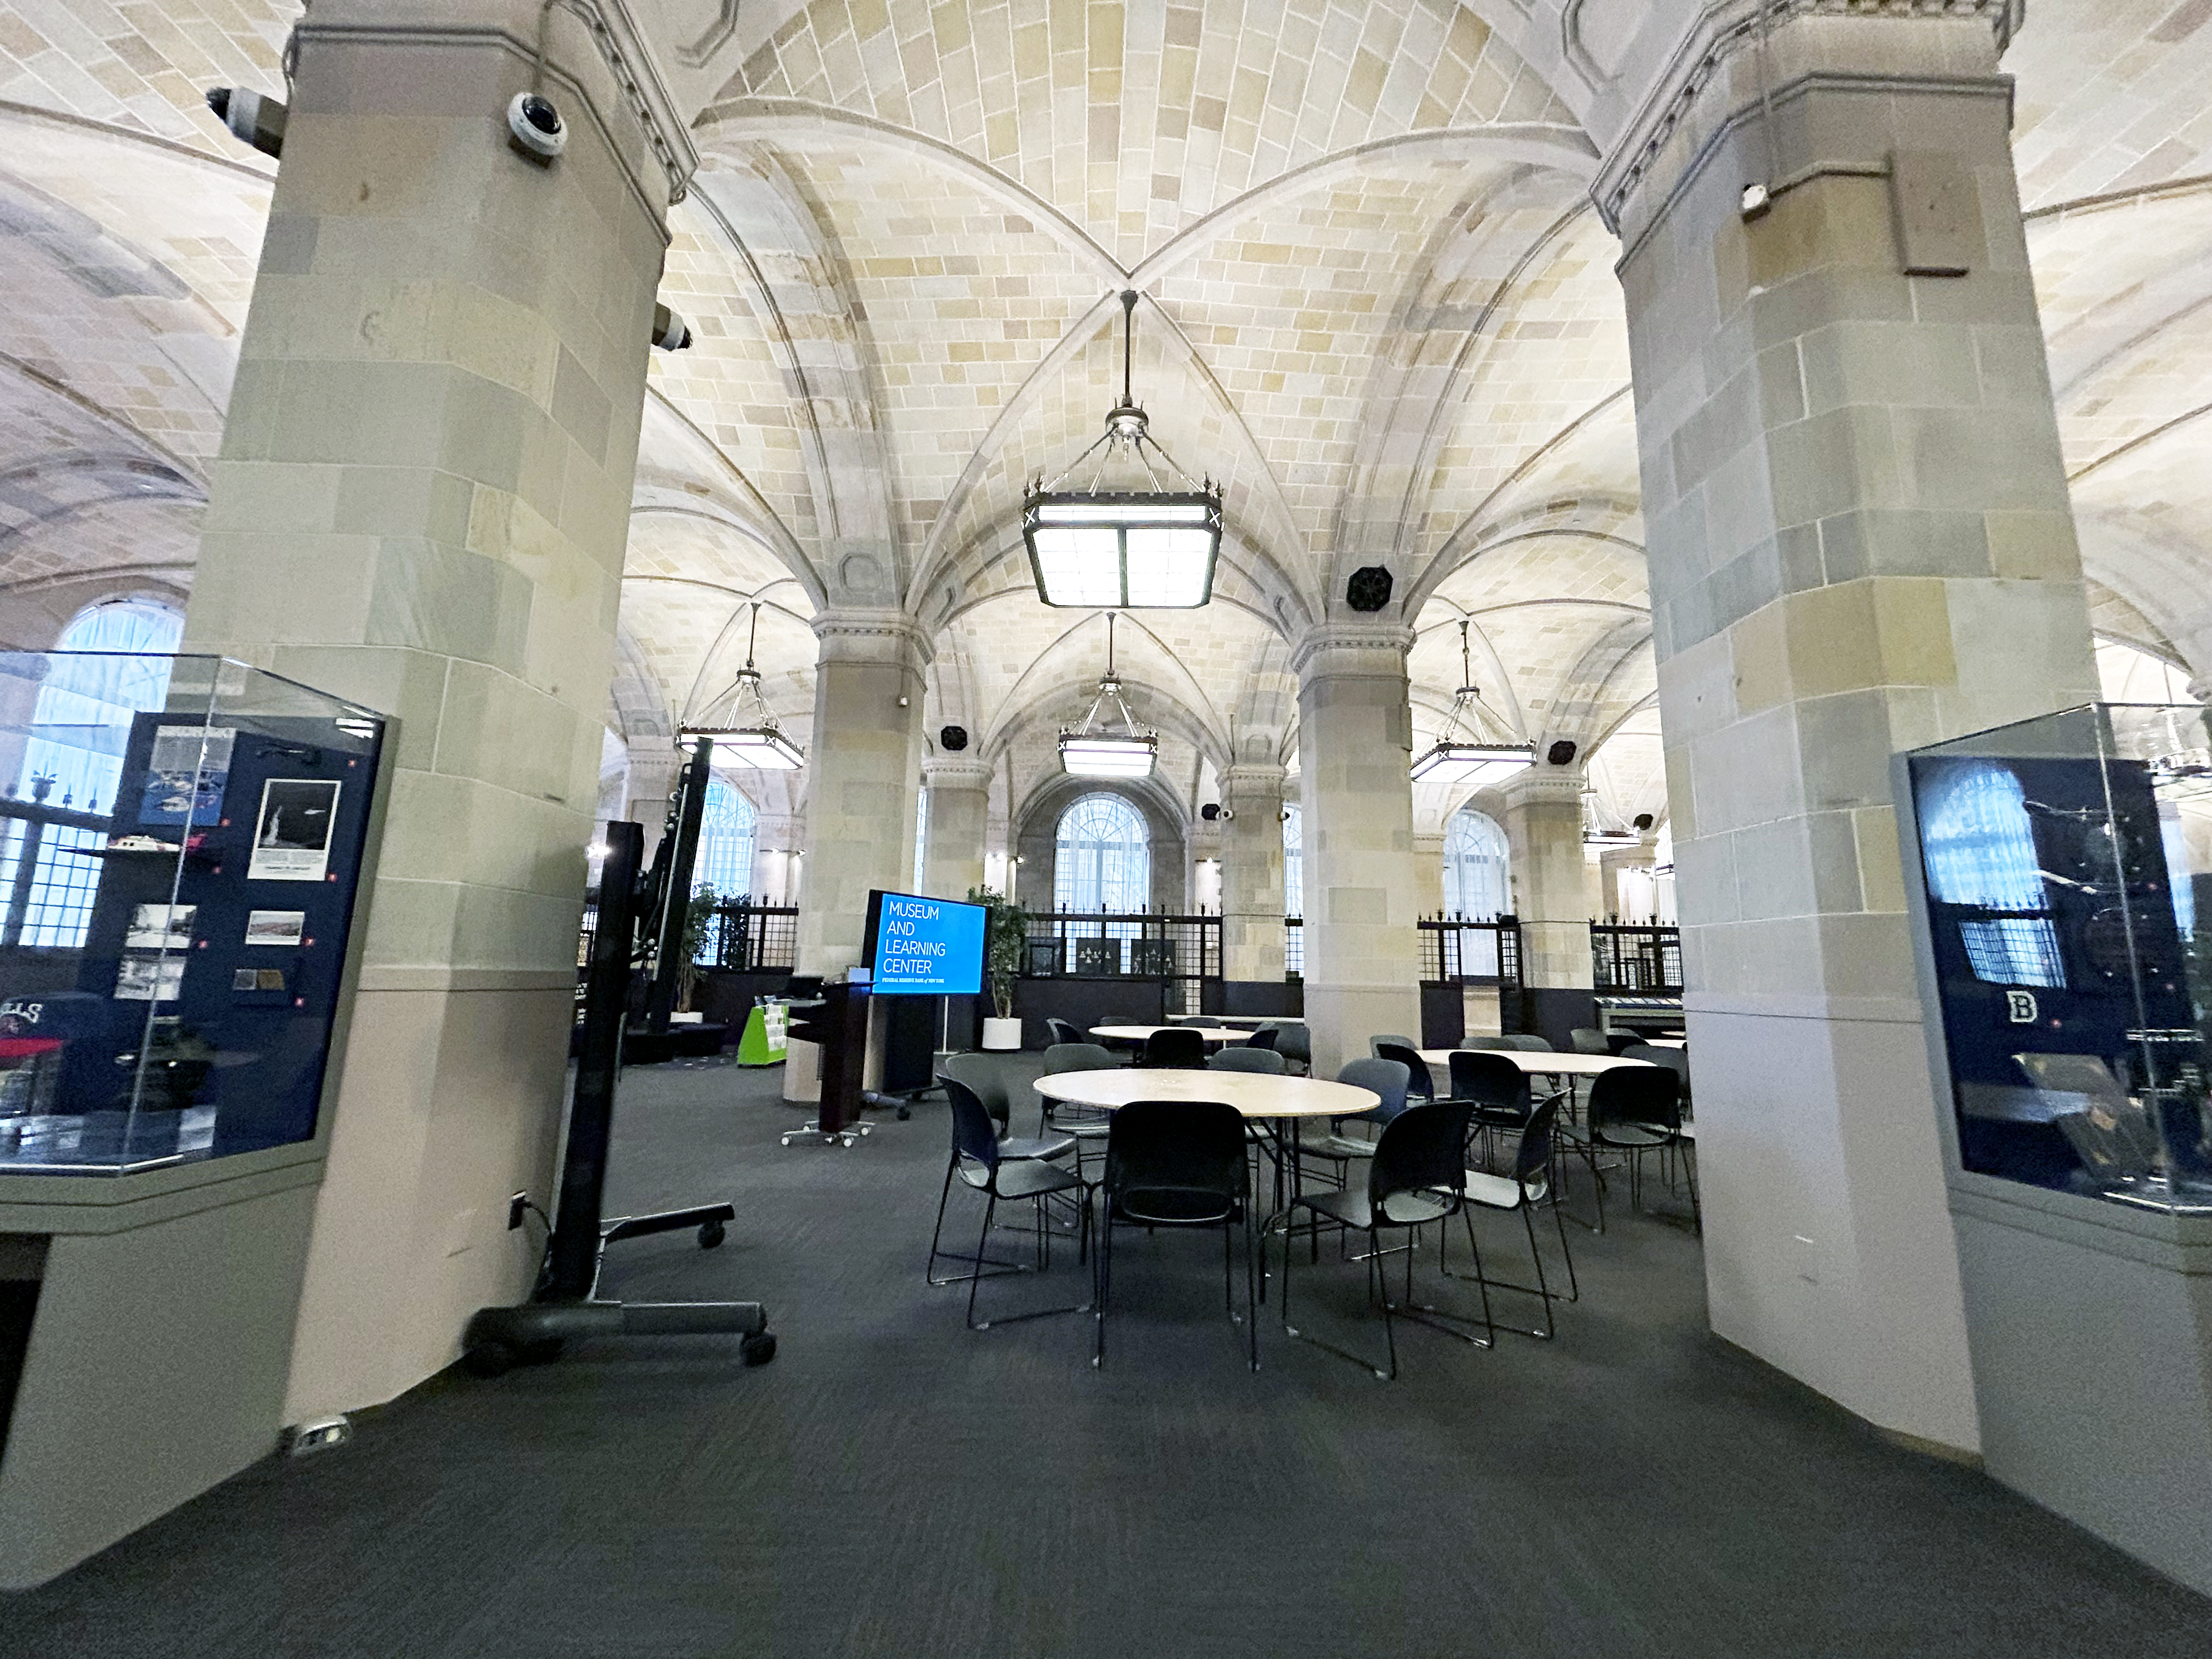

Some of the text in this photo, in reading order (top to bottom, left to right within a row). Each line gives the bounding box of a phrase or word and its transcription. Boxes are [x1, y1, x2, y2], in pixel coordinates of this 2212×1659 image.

[889, 901, 939, 921] MUSEUM
[887, 920, 915, 936] AND
[885, 939, 946, 956] LEARNING
[883, 958, 932, 974] CENTER
[2006, 990, 2038, 1023] B
